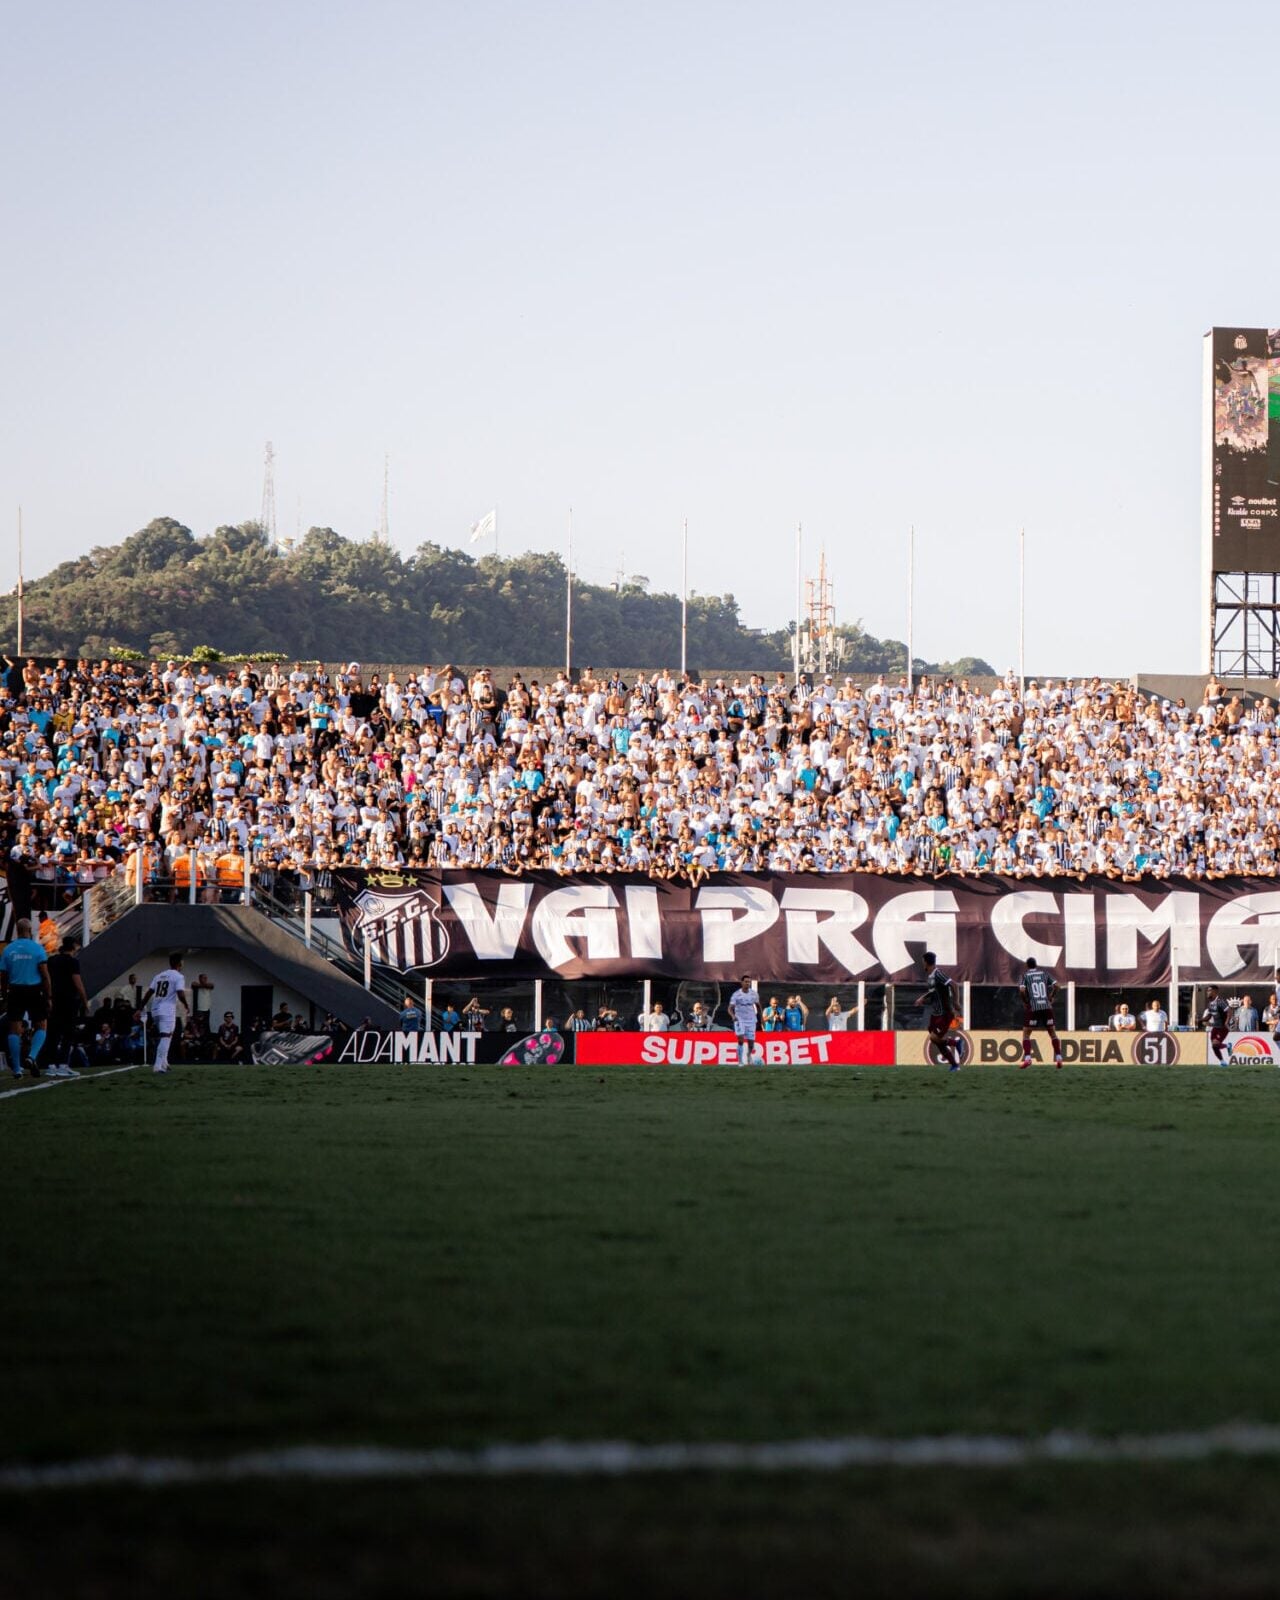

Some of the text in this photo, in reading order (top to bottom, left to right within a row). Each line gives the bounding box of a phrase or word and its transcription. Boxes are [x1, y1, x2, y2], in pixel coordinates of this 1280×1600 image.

[442, 882, 663, 968] VAI
[694, 886, 960, 974] PRA
[155, 980, 170, 998] 18
[1031, 982, 1047, 998] 90
[338, 1031, 482, 1063] ADAMANT
[641, 1034, 832, 1065] SUPERBET
[1054, 1039, 1124, 1063] DEIA
[1143, 1037, 1167, 1064] 51
[1229, 1055, 1274, 1065] Aurora
